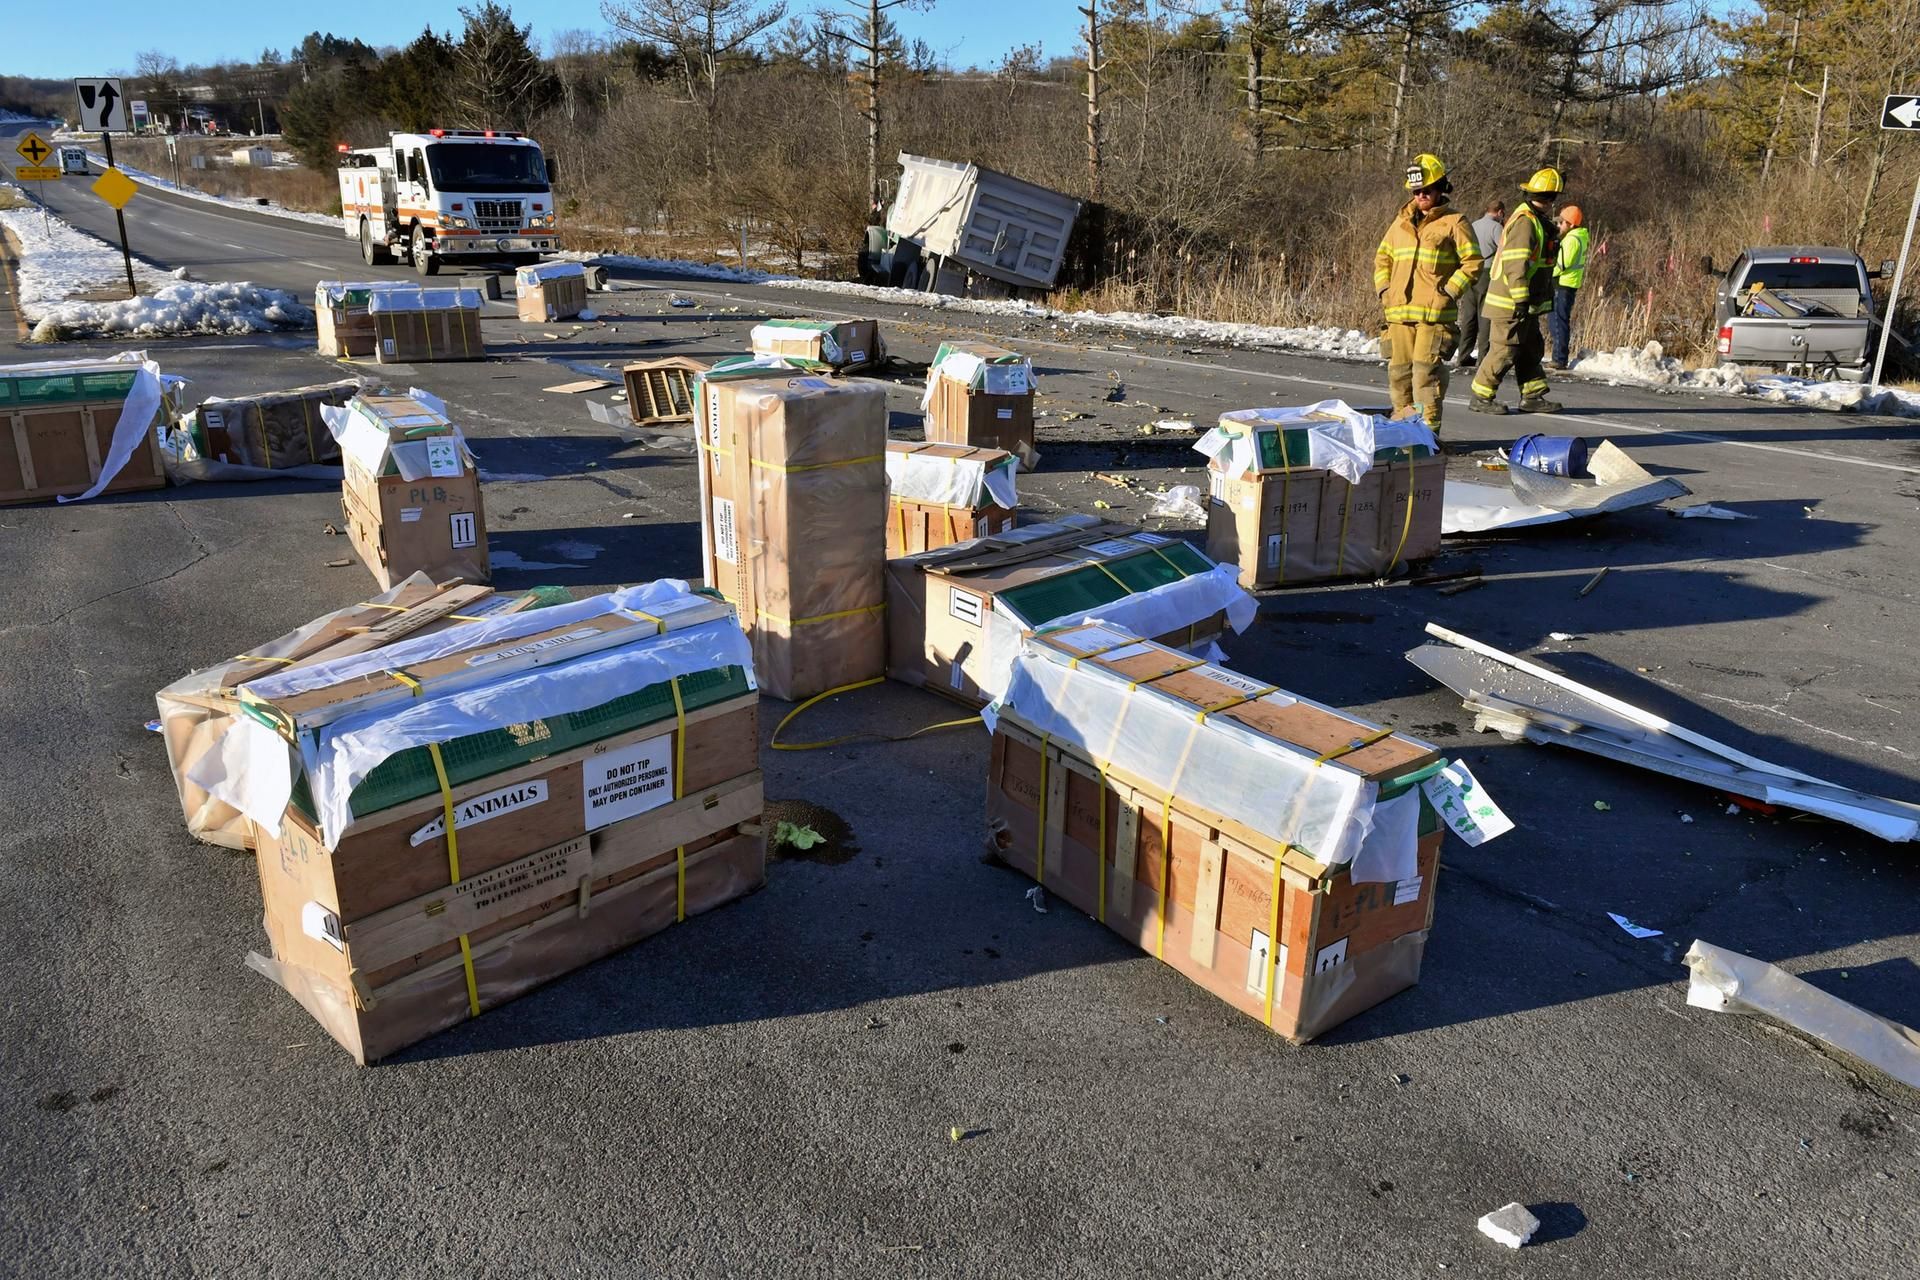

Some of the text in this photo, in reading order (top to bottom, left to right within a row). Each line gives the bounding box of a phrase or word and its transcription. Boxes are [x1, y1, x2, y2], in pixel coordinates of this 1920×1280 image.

[588, 766, 668, 798] ONLY AUTHORIZED PERSONNEL
[606, 758, 650, 780] DO NOT TIP
[462, 785, 538, 822] ANIMALS
[592, 778, 665, 808] MAY OPEN CONTAINER
